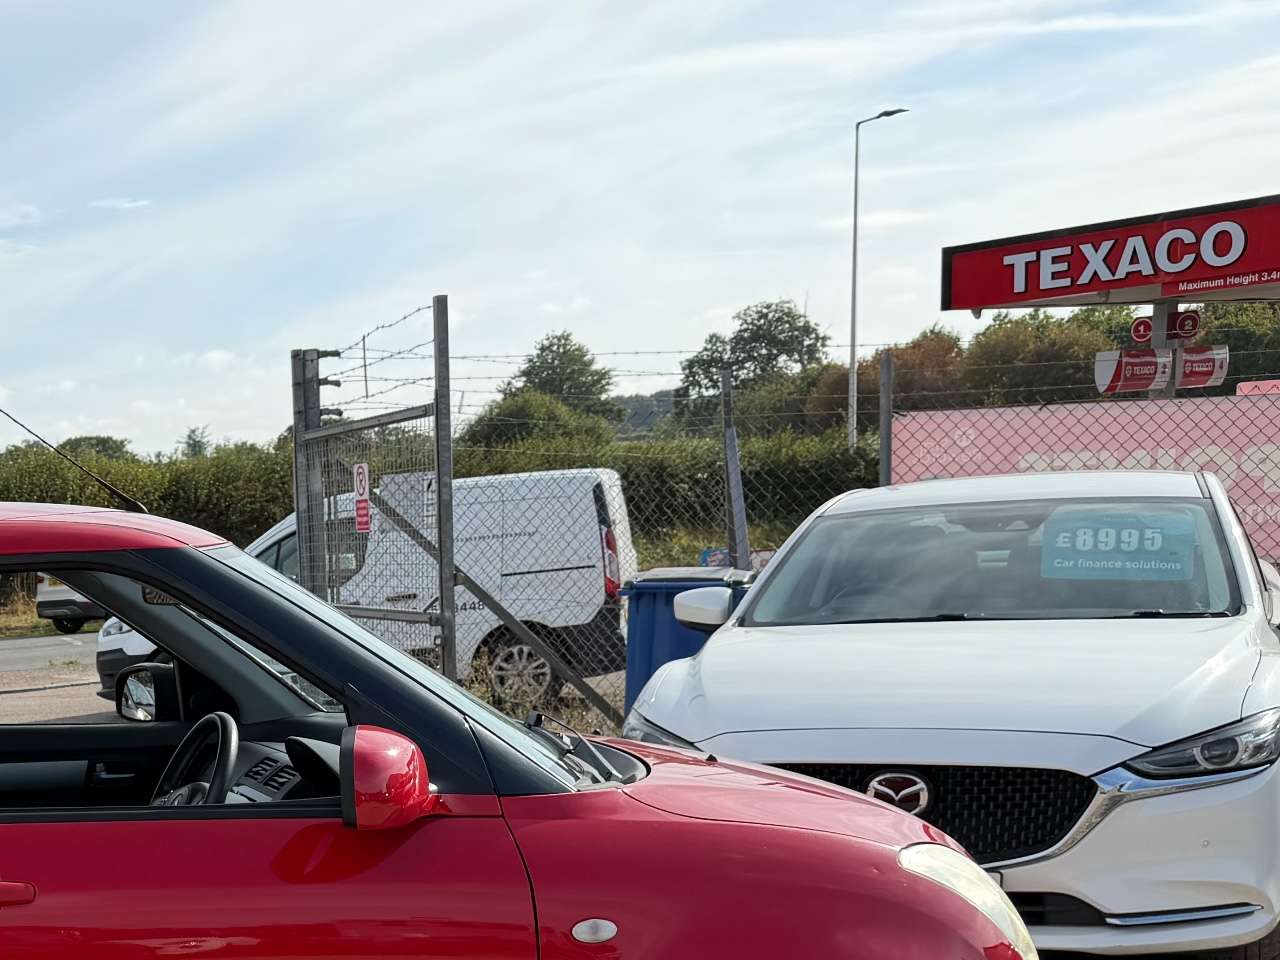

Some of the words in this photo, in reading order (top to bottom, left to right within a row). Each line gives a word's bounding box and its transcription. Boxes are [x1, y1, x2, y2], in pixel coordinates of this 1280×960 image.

[1003, 221, 1245, 293] TEXACO
[1178, 278, 1224, 291] Maximum
[1226, 273, 1258, 285] Height
[1184, 320, 1193, 330] 2
[1055, 528, 1163, 551] £8995
[1054, 558, 1074, 568] Car
[1077, 558, 1122, 568] finance
[1125, 559, 1182, 570] solutions
